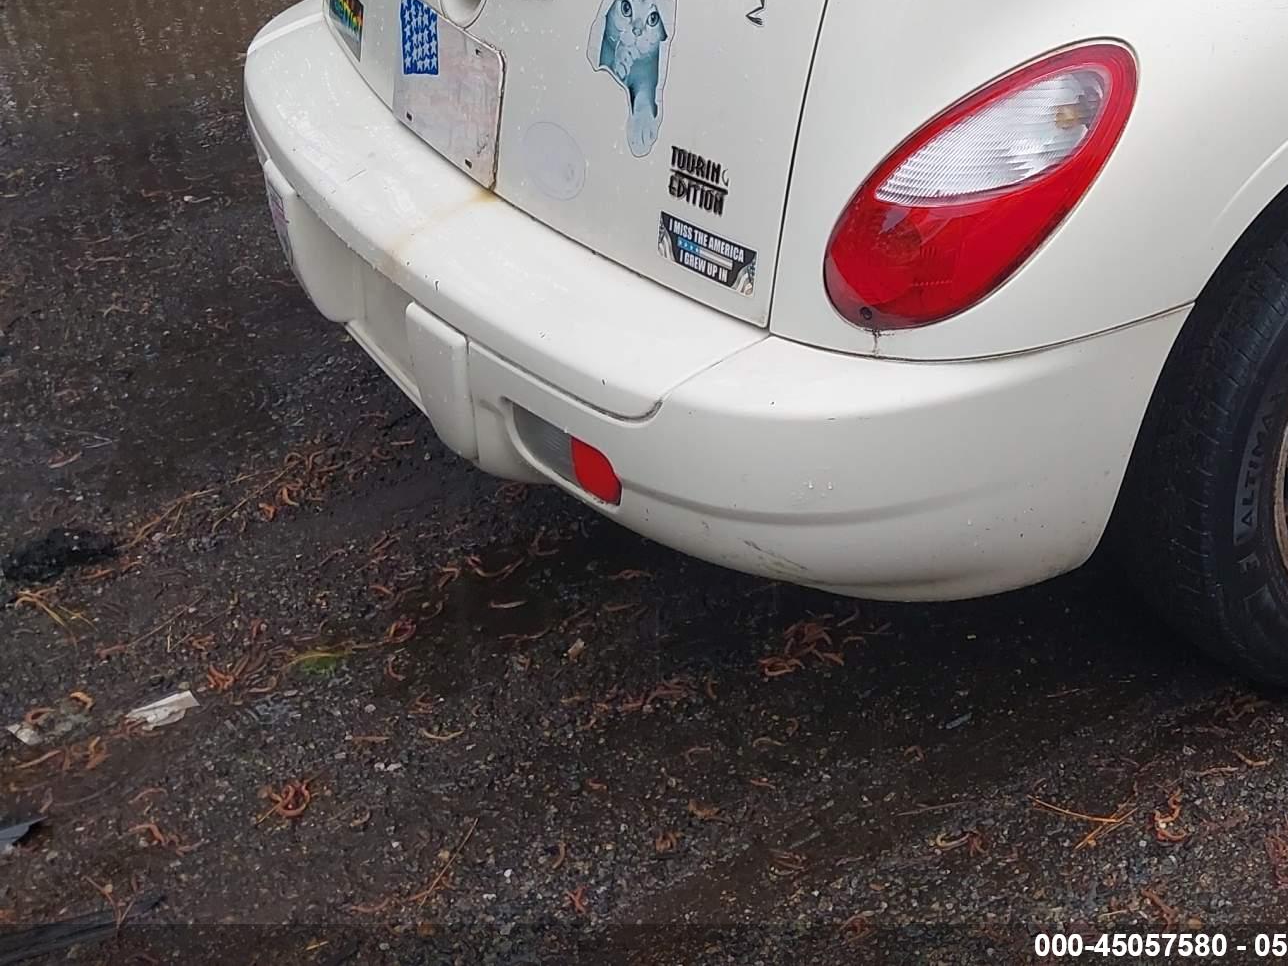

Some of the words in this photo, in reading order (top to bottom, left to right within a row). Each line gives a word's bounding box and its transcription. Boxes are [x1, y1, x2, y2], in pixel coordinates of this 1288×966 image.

[668, 174, 725, 216] EDITION
[674, 220, 693, 239] MISS
[694, 228, 709, 247] THE
[708, 234, 745, 263] AMERICA
[684, 251, 706, 273] GREW
[707, 262, 718, 279] UP
[718, 267, 728, 283] IN
